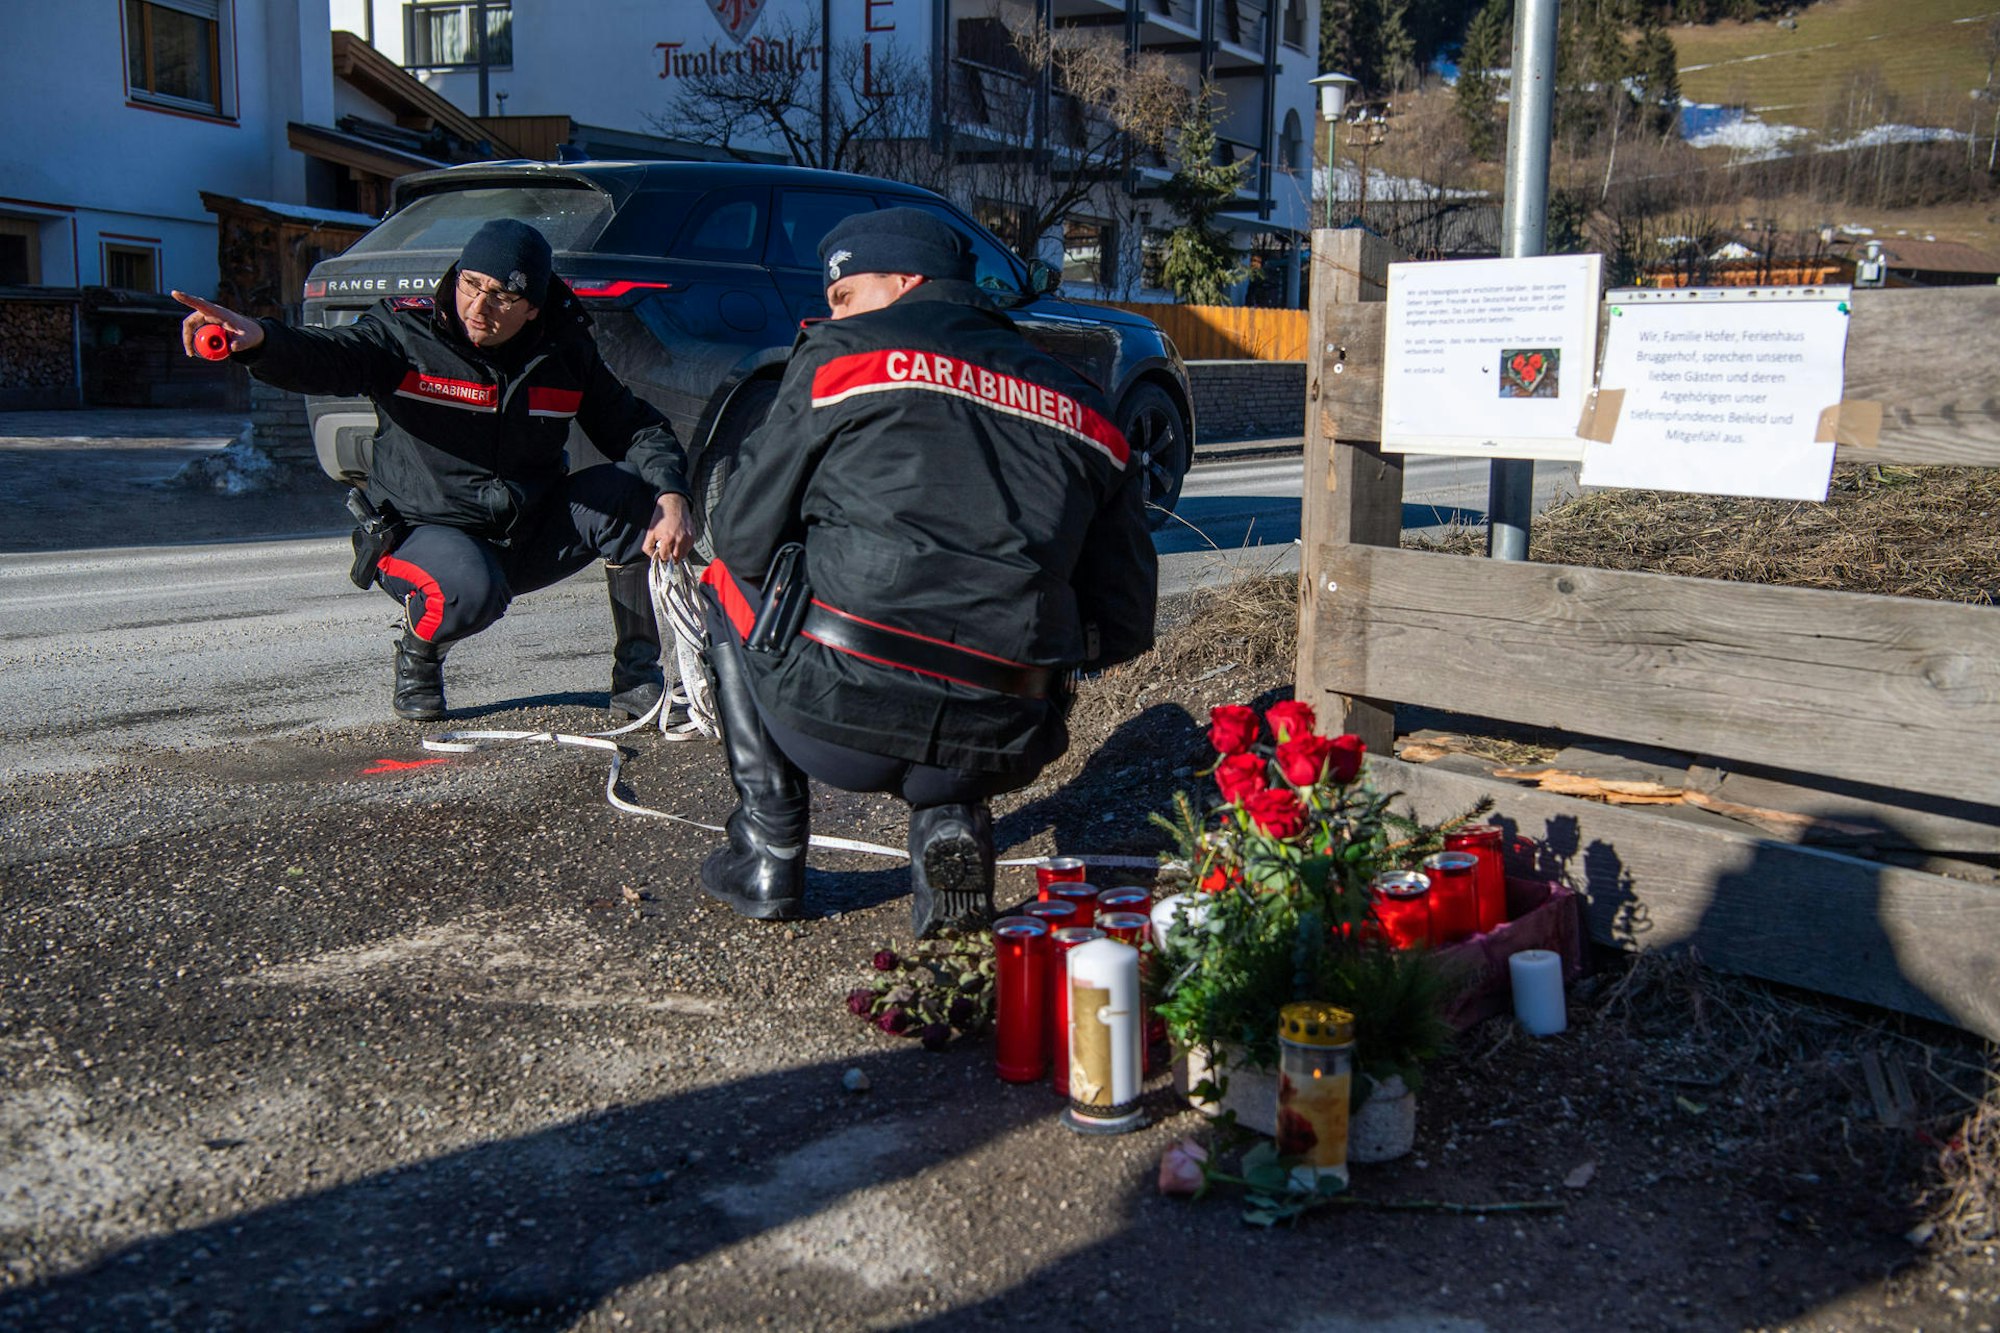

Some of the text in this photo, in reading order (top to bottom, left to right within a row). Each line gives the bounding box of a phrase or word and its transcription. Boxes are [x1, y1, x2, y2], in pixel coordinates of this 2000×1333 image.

[329, 279, 387, 290] RANGE
[1639, 330, 1805, 343] Wir, Familie Hofer, Ferienhaus
[1636, 351, 1803, 364] Bruggerhof, sprechen unseren
[1648, 371, 1786, 383] lieben Gästen und deren
[419, 381, 489, 401] CARABINIERI
[887, 352, 1082, 429] CARABINIERI
[1660, 390, 1767, 405] Angehörigen unser
[1630, 408, 1793, 425] tiefempfundenes Beileid und
[1665, 429, 1721, 444] Mitgefühl
